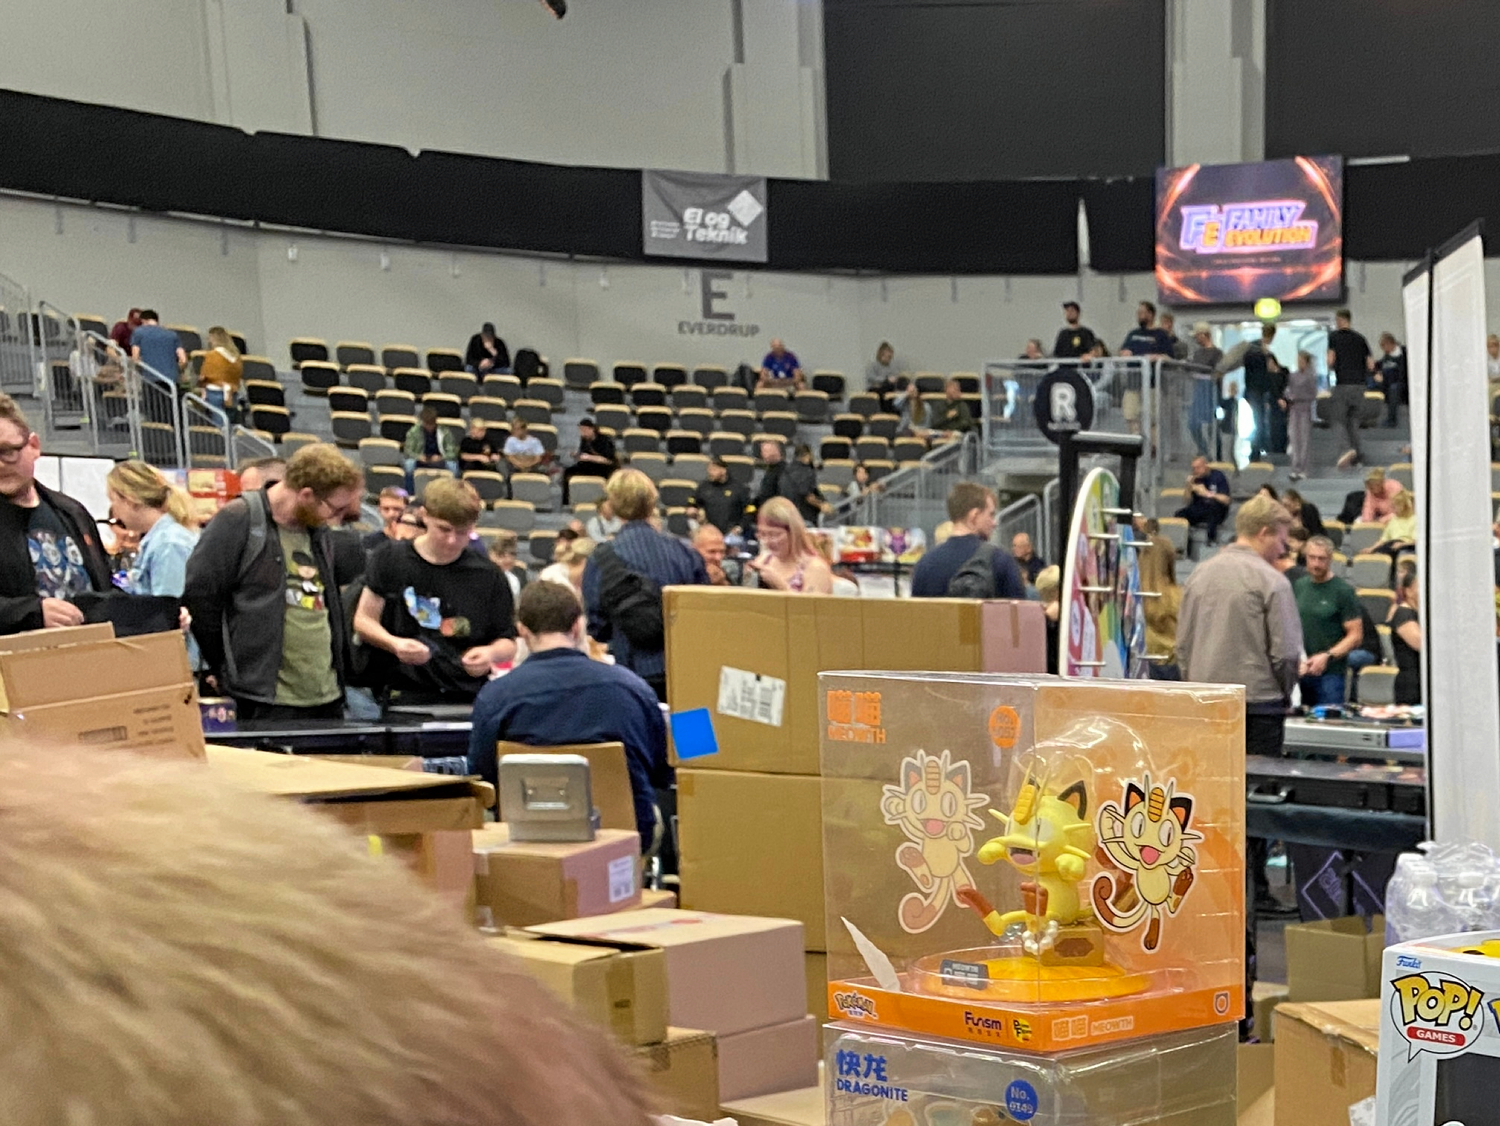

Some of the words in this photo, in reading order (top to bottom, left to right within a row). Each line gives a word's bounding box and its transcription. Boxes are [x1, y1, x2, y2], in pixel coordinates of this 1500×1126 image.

[705, 212, 730, 230] og
[1228, 206, 1299, 229] FAMILY
[685, 225, 748, 244] Teknik
[1225, 227, 1312, 246] EVOLUTION
[702, 269, 735, 320] E
[678, 321, 760, 337] EVERDRUP
[1050, 382, 1077, 422] R
[834, 991, 874, 1014] Pokémon
[1390, 974, 1484, 1036] POP!
[1092, 1017, 1133, 1035] MEOWTH
[1416, 1029, 1456, 1045] GAMES
[836, 1049, 888, 1082] 快龙
[836, 1078, 908, 1102] DRAGONITE
